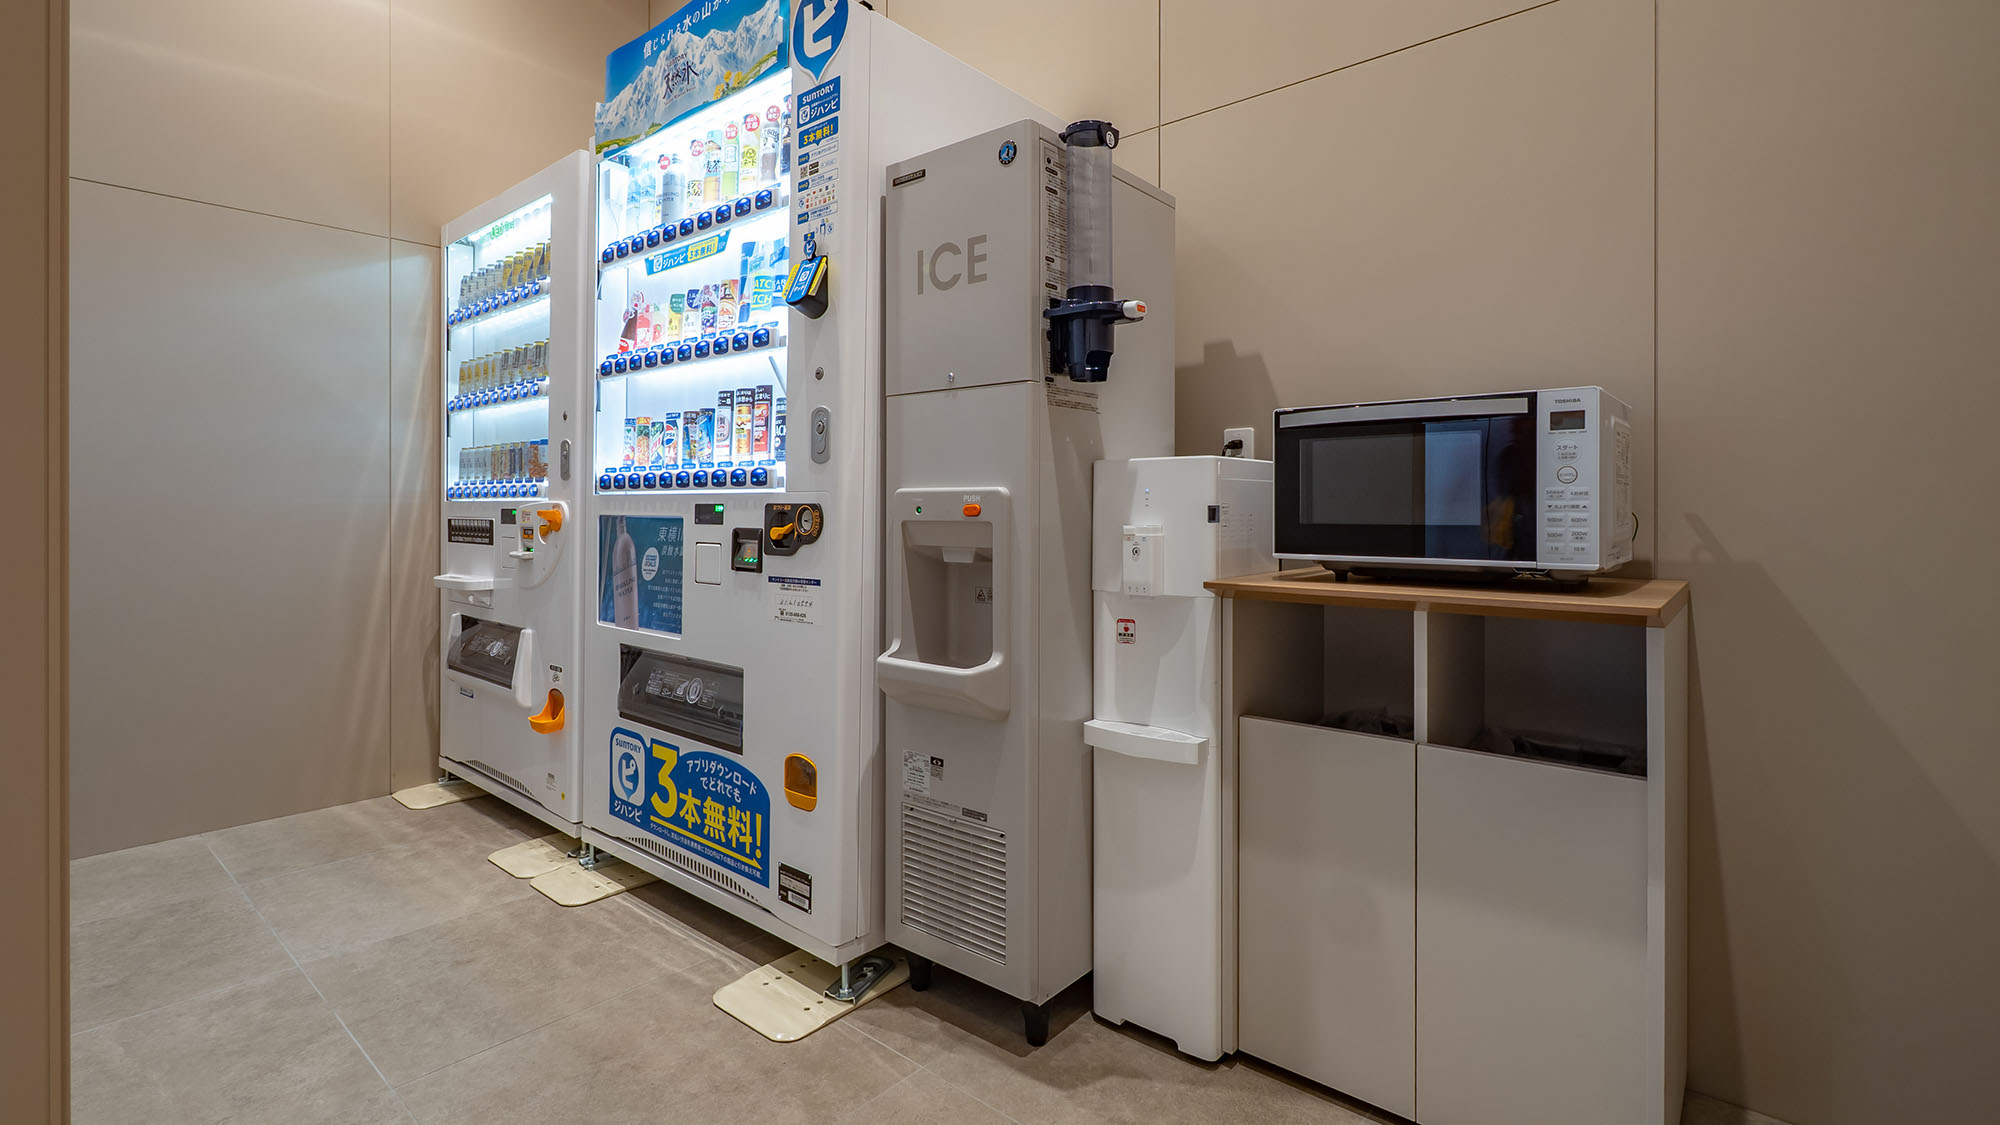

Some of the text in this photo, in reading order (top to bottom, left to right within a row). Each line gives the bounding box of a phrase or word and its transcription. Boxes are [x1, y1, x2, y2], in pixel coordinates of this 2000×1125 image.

[644, 0, 731, 59] 信じられる水の山か
[663, 60, 699, 99] 天然水
[802, 83, 835, 105] SUNTORY
[811, 98, 839, 119] ジハンピ
[803, 124, 834, 145] 3本無料!
[663, 253, 687, 269] ジハンピ
[917, 234, 988, 295] ICE
[963, 494, 981, 502] PUSH
[616, 738, 641, 753] SUNTORY
[622, 759, 636, 791] ピ
[686, 757, 758, 796] アプリダウンロード
[649, 743, 763, 860] 3本無料!
[700, 776, 742, 804] でどれでも
[614, 799, 643, 823] ジハンピ
